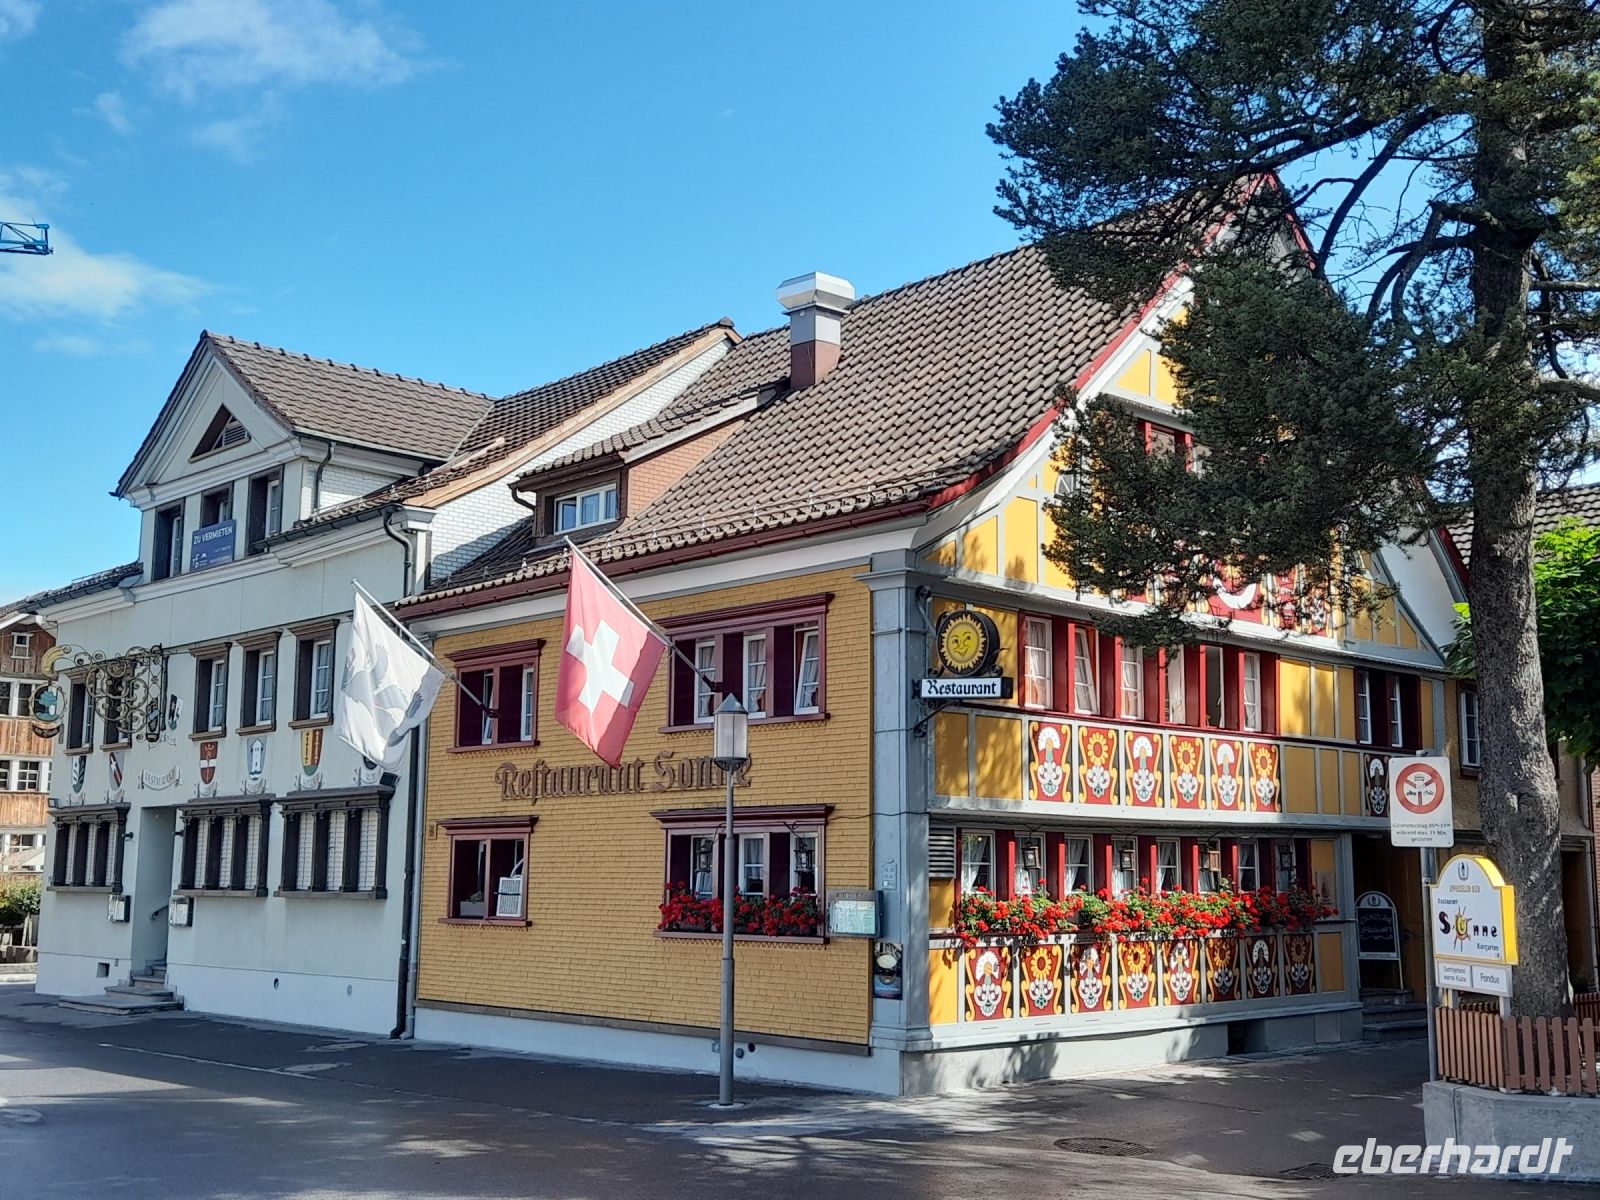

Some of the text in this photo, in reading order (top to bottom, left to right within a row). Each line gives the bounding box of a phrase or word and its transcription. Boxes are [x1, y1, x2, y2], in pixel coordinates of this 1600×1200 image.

[193, 526, 233, 545] ZU VERMIETEN
[926, 679, 997, 695] Restaurant
[1438, 908, 1499, 942] Sonne
[1480, 972, 1500, 985] Fondue
